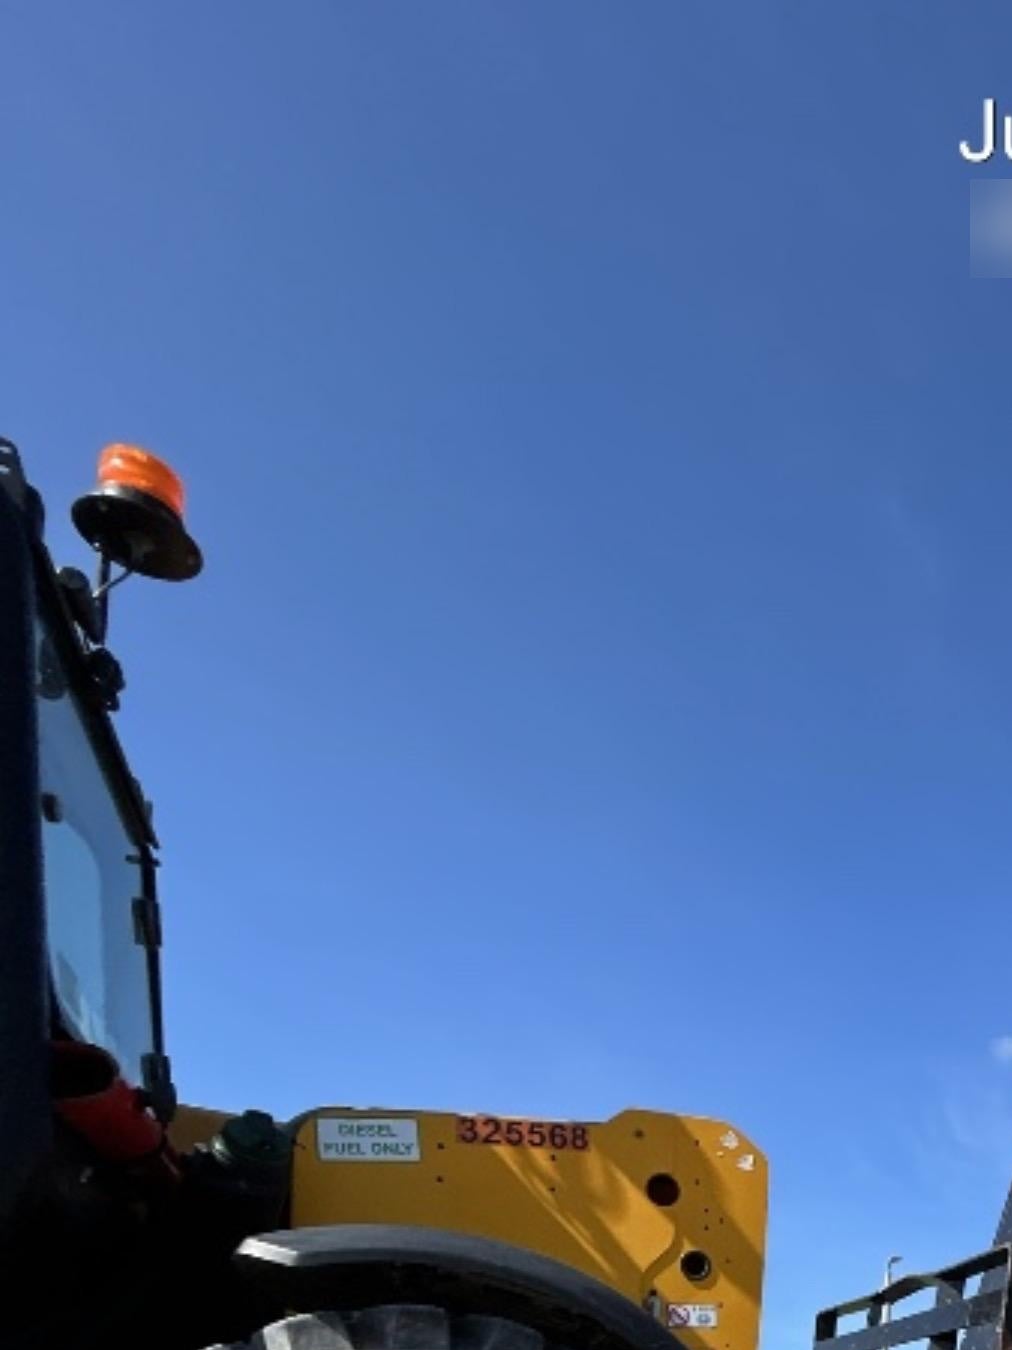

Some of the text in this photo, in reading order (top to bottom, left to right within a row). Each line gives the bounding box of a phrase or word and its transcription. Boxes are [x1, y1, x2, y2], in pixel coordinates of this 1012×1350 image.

[337, 1123, 398, 1138] DIESEL
[459, 1116, 589, 1150] 325568
[323, 1142, 415, 1156] FUEL ONLY
